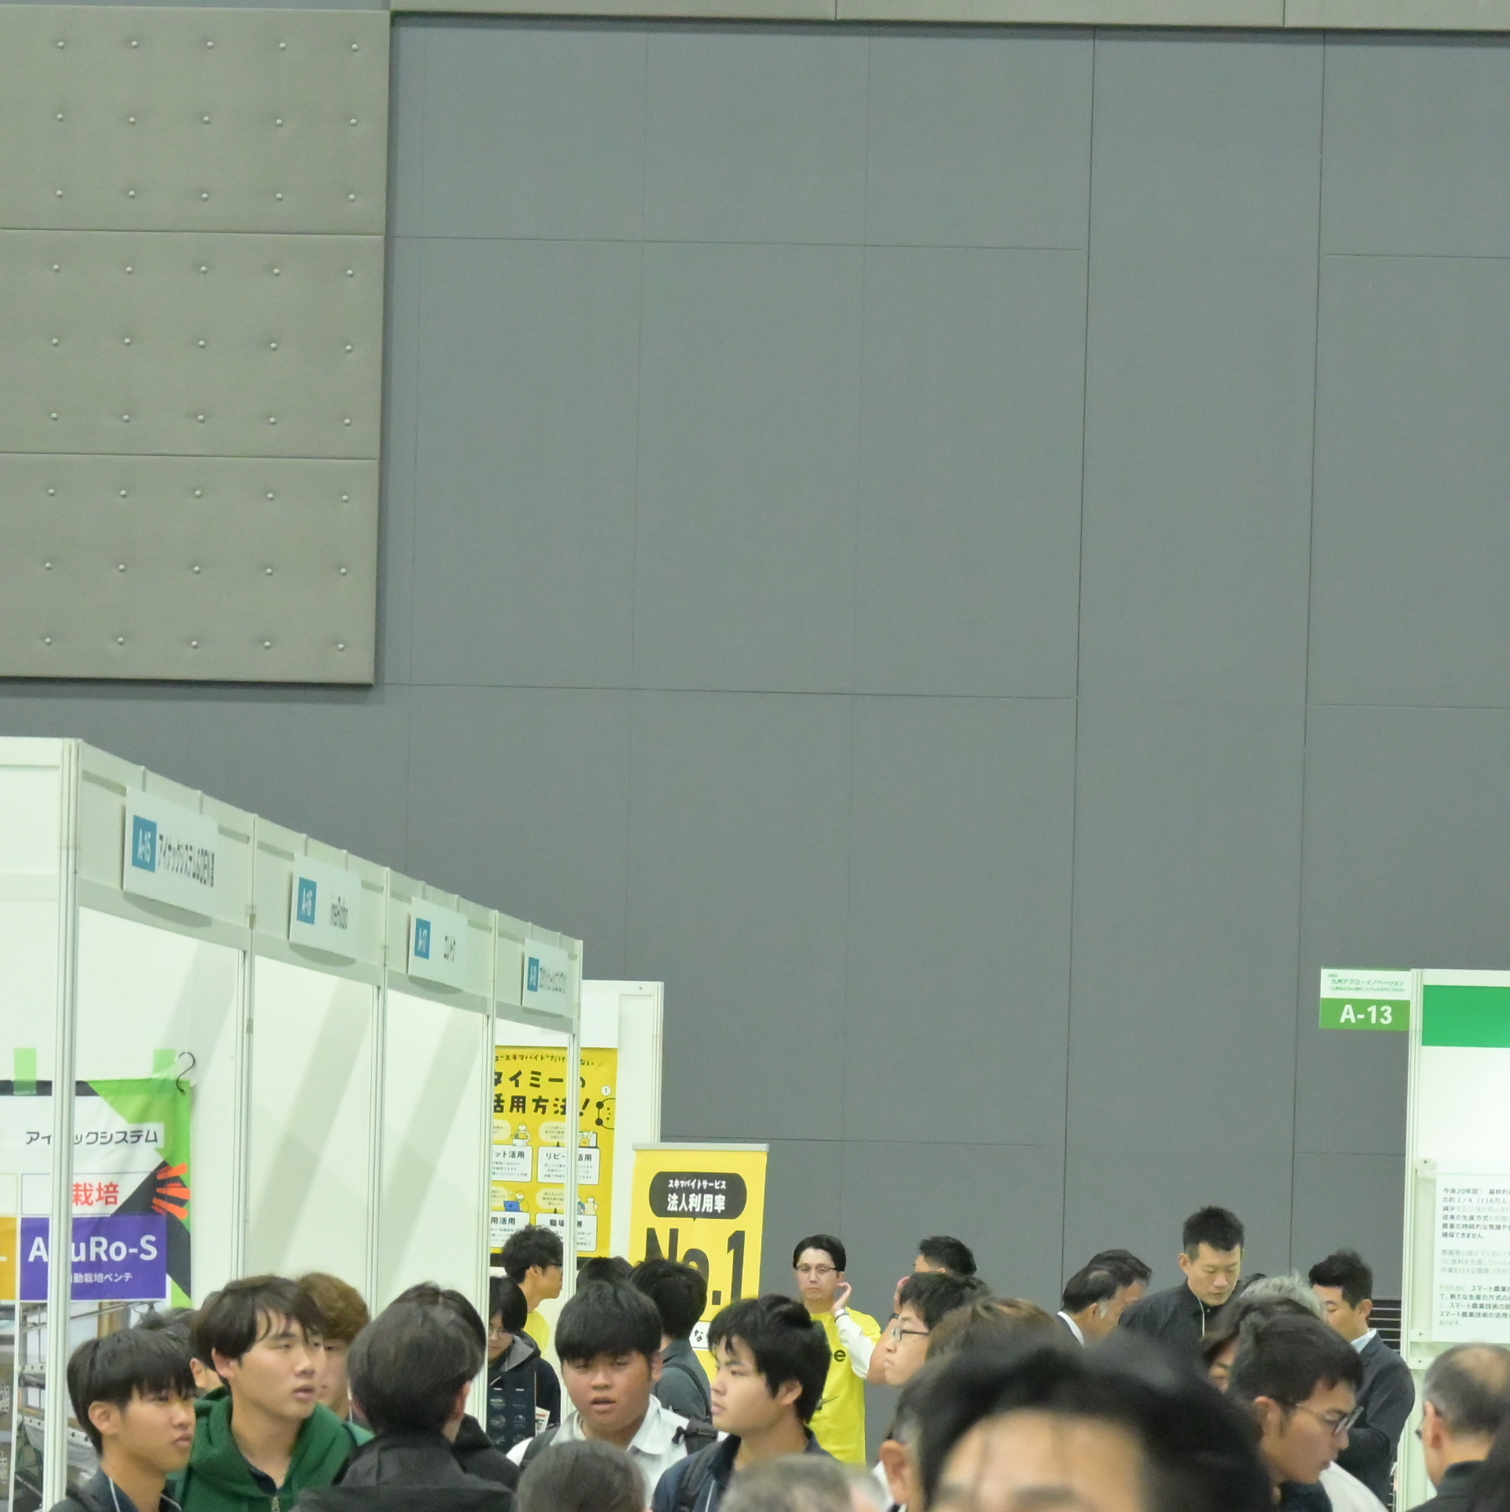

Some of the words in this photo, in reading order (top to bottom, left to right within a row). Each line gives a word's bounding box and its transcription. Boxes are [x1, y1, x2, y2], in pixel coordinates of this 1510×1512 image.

[1339, 1004, 1393, 1025] A-13
[26, 1129, 159, 1147] アイックシステム
[546, 1151, 593, 1163] リピー活用
[668, 1178, 727, 1190] スキマバイトサービス
[71, 1181, 120, 1207] 栽培
[666, 1192, 727, 1214] 法人利用率
[28, 1235, 158, 1263] AuRo-S
[69, 1271, 133, 1285] 動栽培ベンチ
